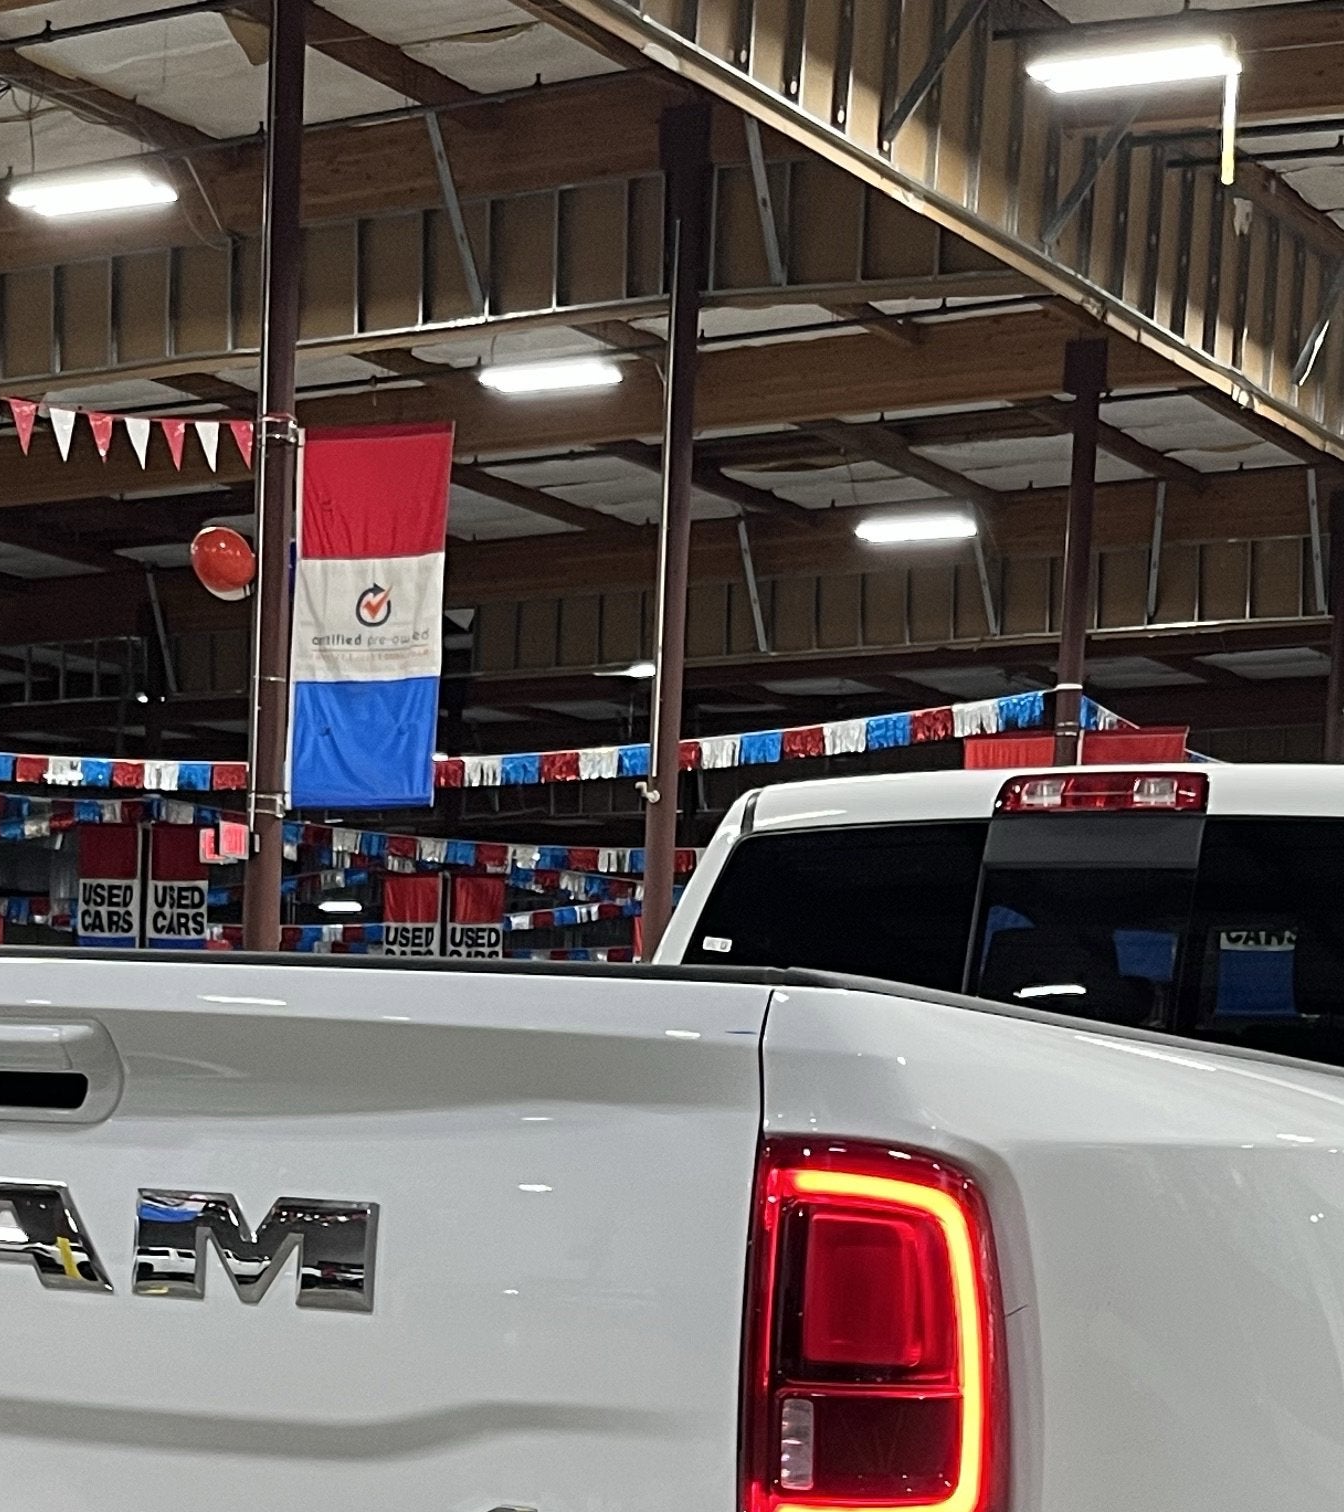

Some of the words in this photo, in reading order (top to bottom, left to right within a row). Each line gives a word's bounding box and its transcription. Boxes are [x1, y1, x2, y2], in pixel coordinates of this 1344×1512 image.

[368, 628, 429, 647] pre-owed
[82, 883, 133, 908] USED
[154, 885, 205, 909] USED
[81, 909, 133, 933] CARS
[152, 911, 205, 936] CARS
[385, 926, 434, 947] USED
[450, 927, 500, 948] USED
